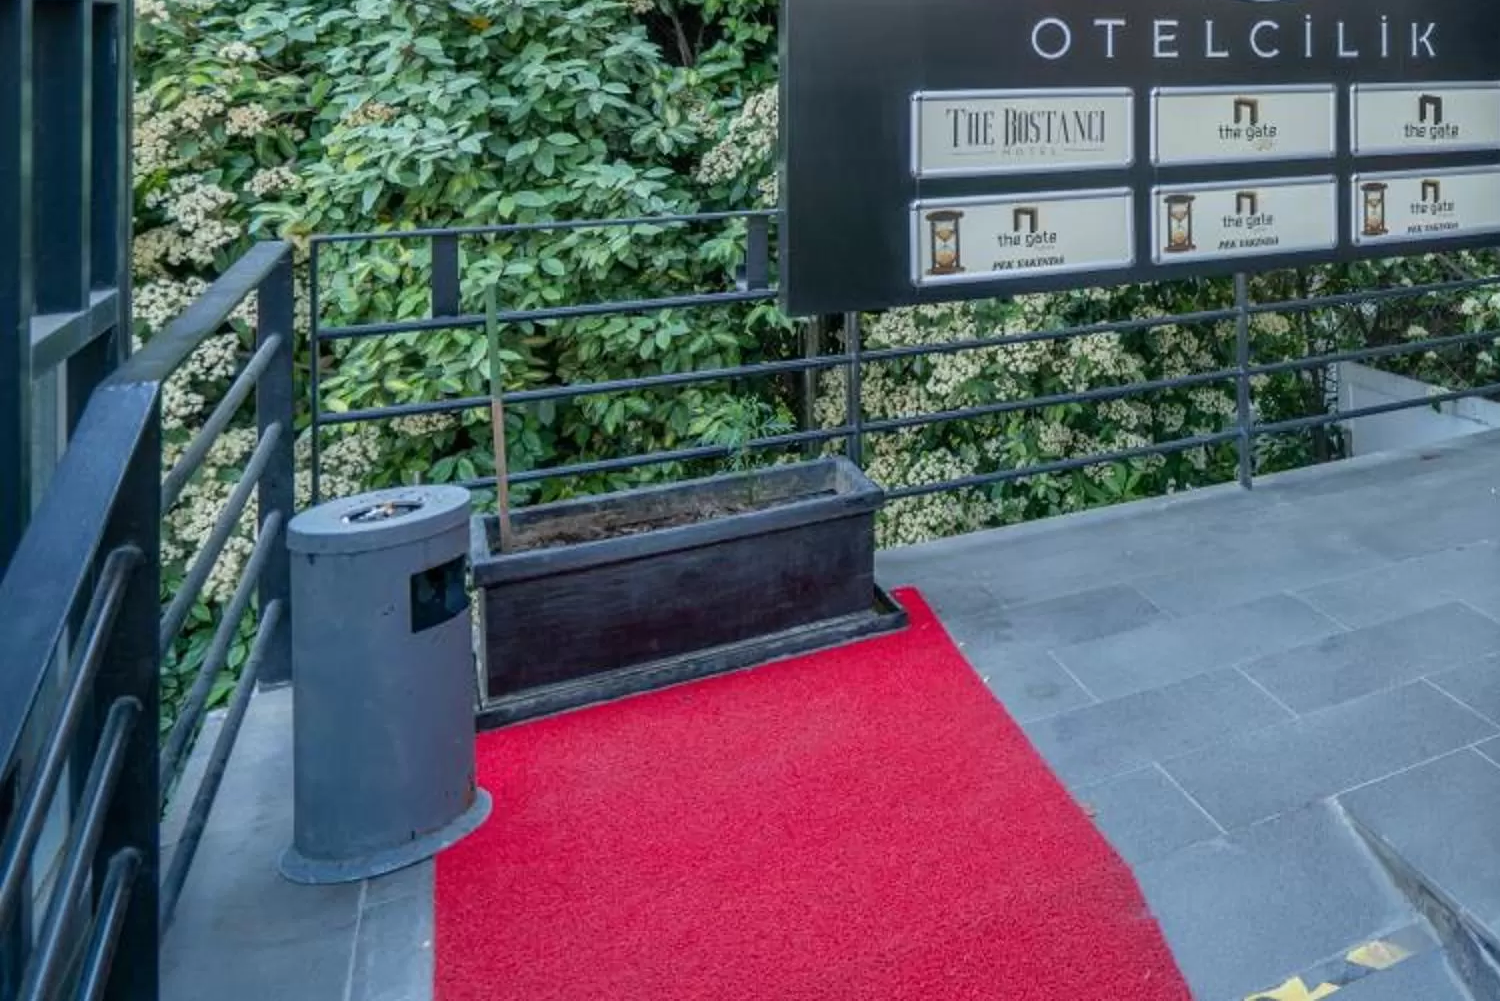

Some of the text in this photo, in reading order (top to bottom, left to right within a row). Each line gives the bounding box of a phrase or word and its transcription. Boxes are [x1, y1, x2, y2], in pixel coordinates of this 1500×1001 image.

[1031, 13, 1438, 60] OTELCİLİK
[946, 108, 995, 148] THE
[1218, 124, 1277, 142] the gate
[1404, 123, 1459, 140] the gate
[1410, 200, 1454, 216] the gate
[1222, 212, 1273, 229] the gate
[997, 230, 1057, 248] the gate
